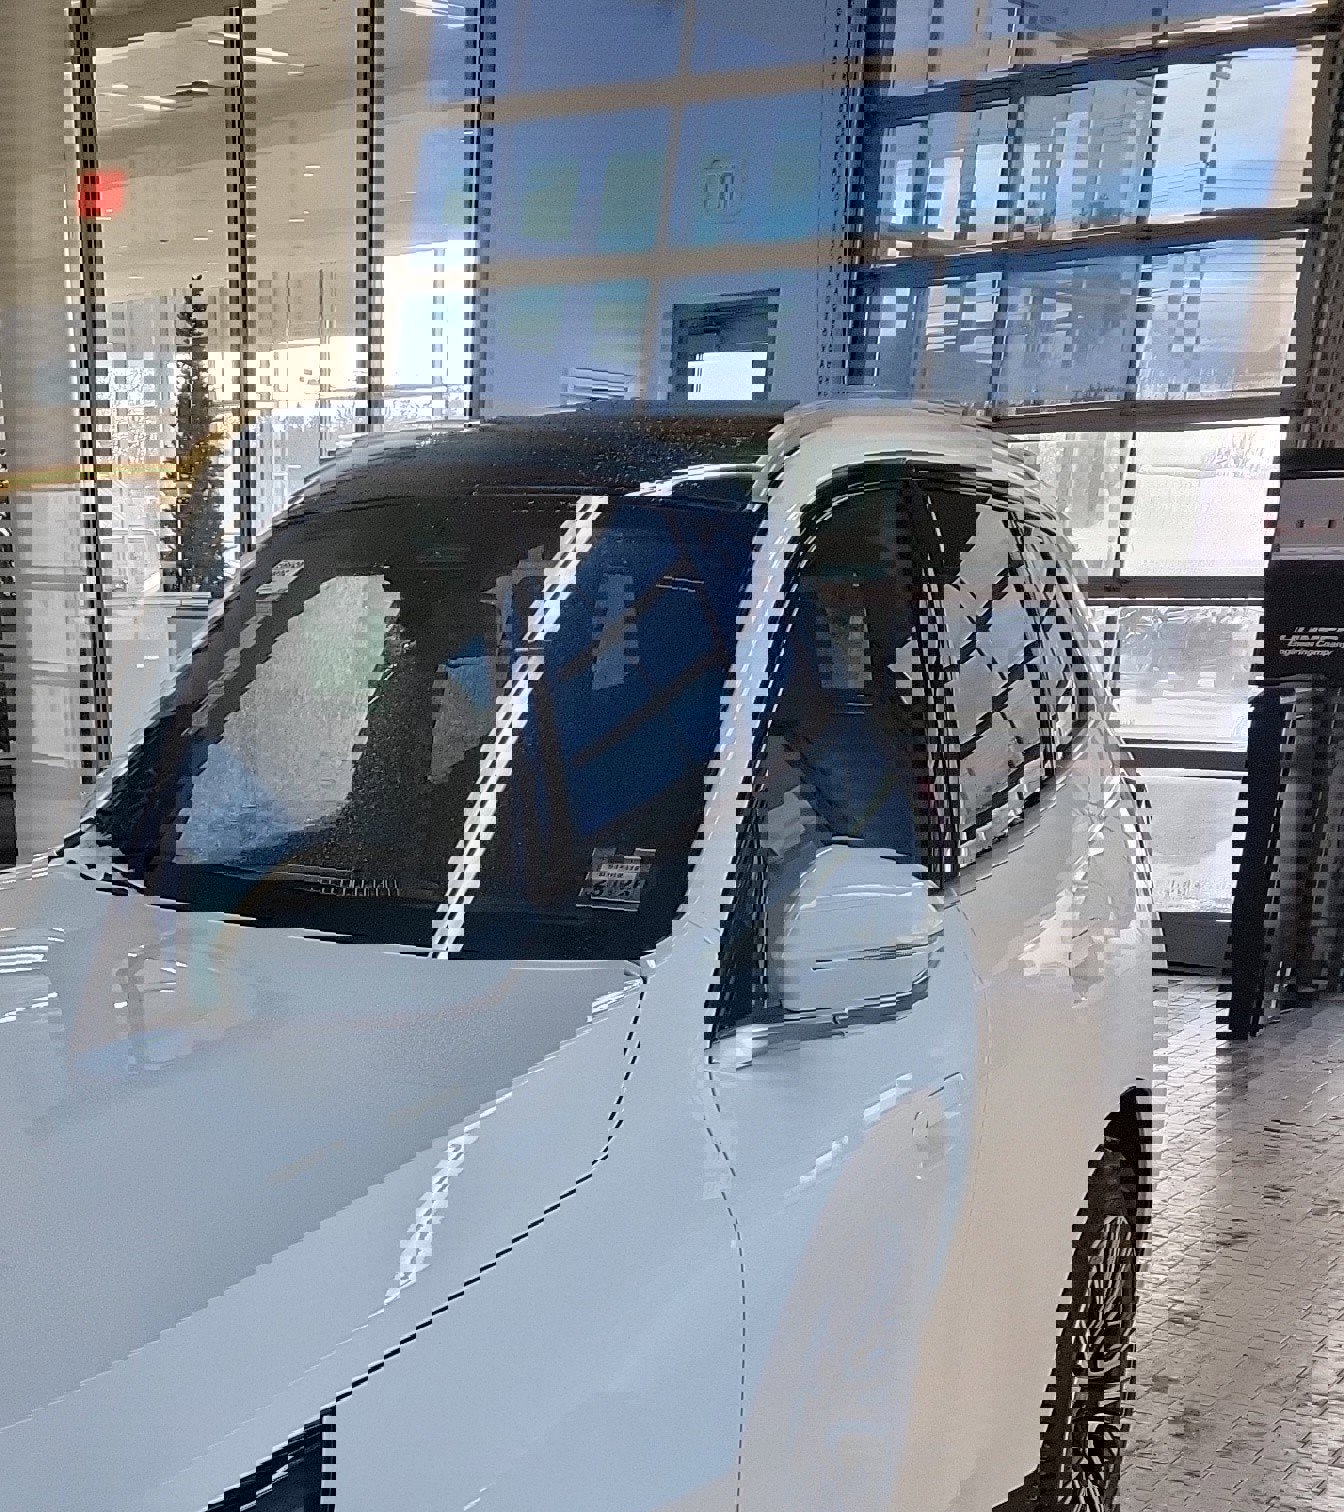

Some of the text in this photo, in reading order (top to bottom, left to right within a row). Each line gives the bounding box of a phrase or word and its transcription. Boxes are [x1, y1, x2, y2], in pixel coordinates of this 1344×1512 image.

[79, 172, 124, 215] EXIT
[1226, 634, 1339, 649] HUNTER
[1223, 647, 1333, 657] Engineering Company
